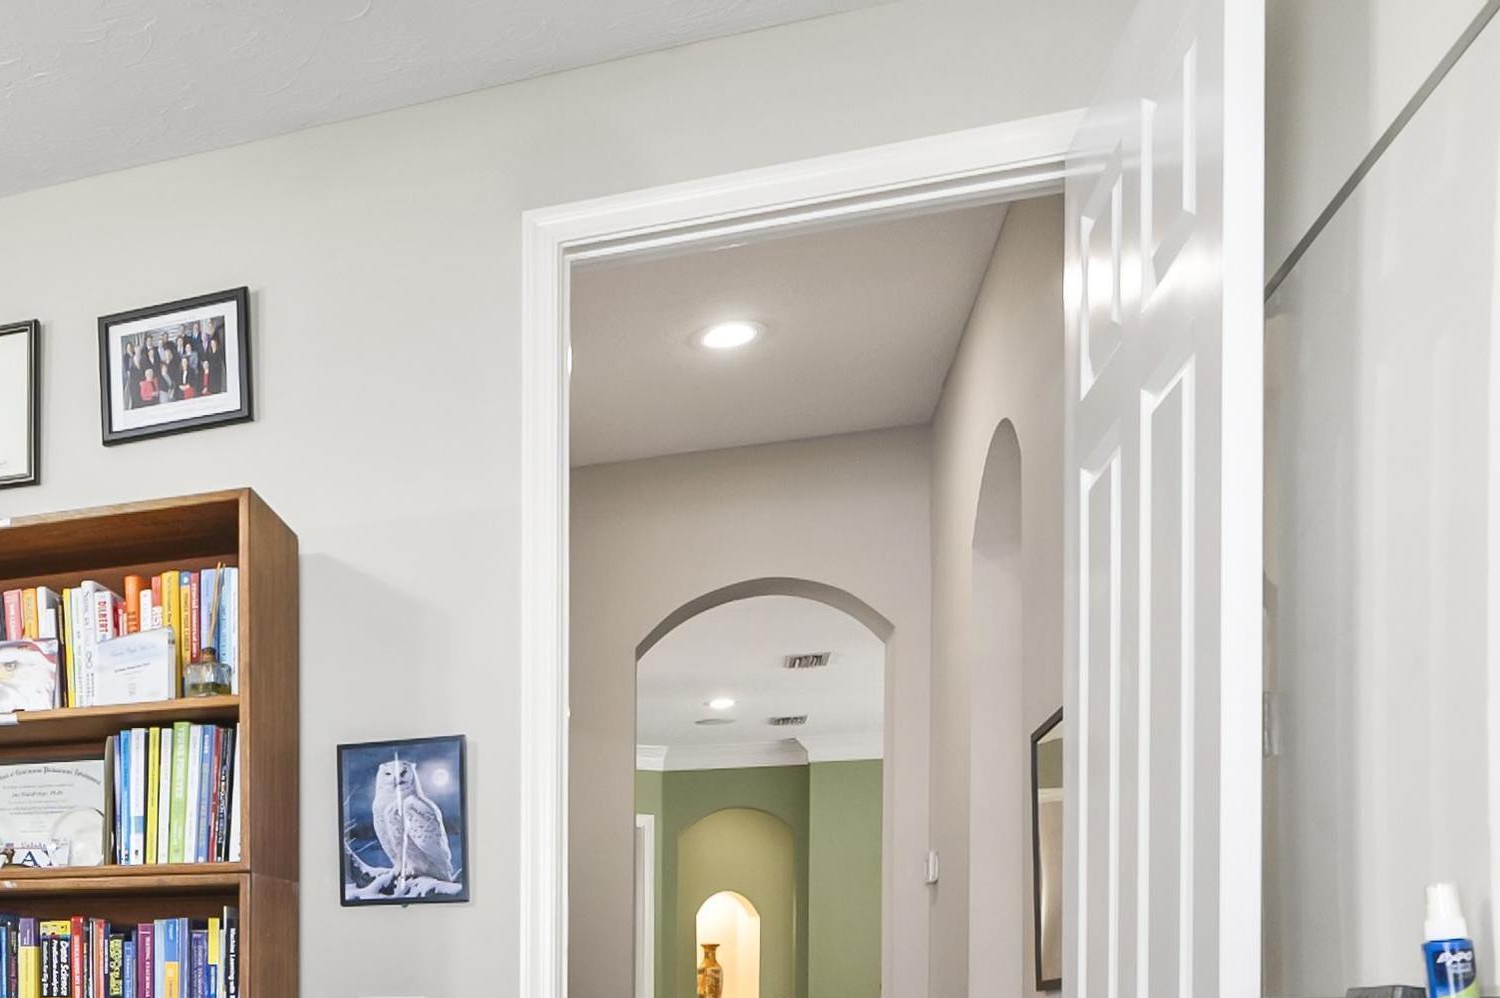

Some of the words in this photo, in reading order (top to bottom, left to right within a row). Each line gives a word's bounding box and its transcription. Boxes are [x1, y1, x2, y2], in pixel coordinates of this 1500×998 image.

[97, 601, 109, 634] DILBERT
[61, 940, 69, 963] Data
[61, 964, 70, 996] Science
